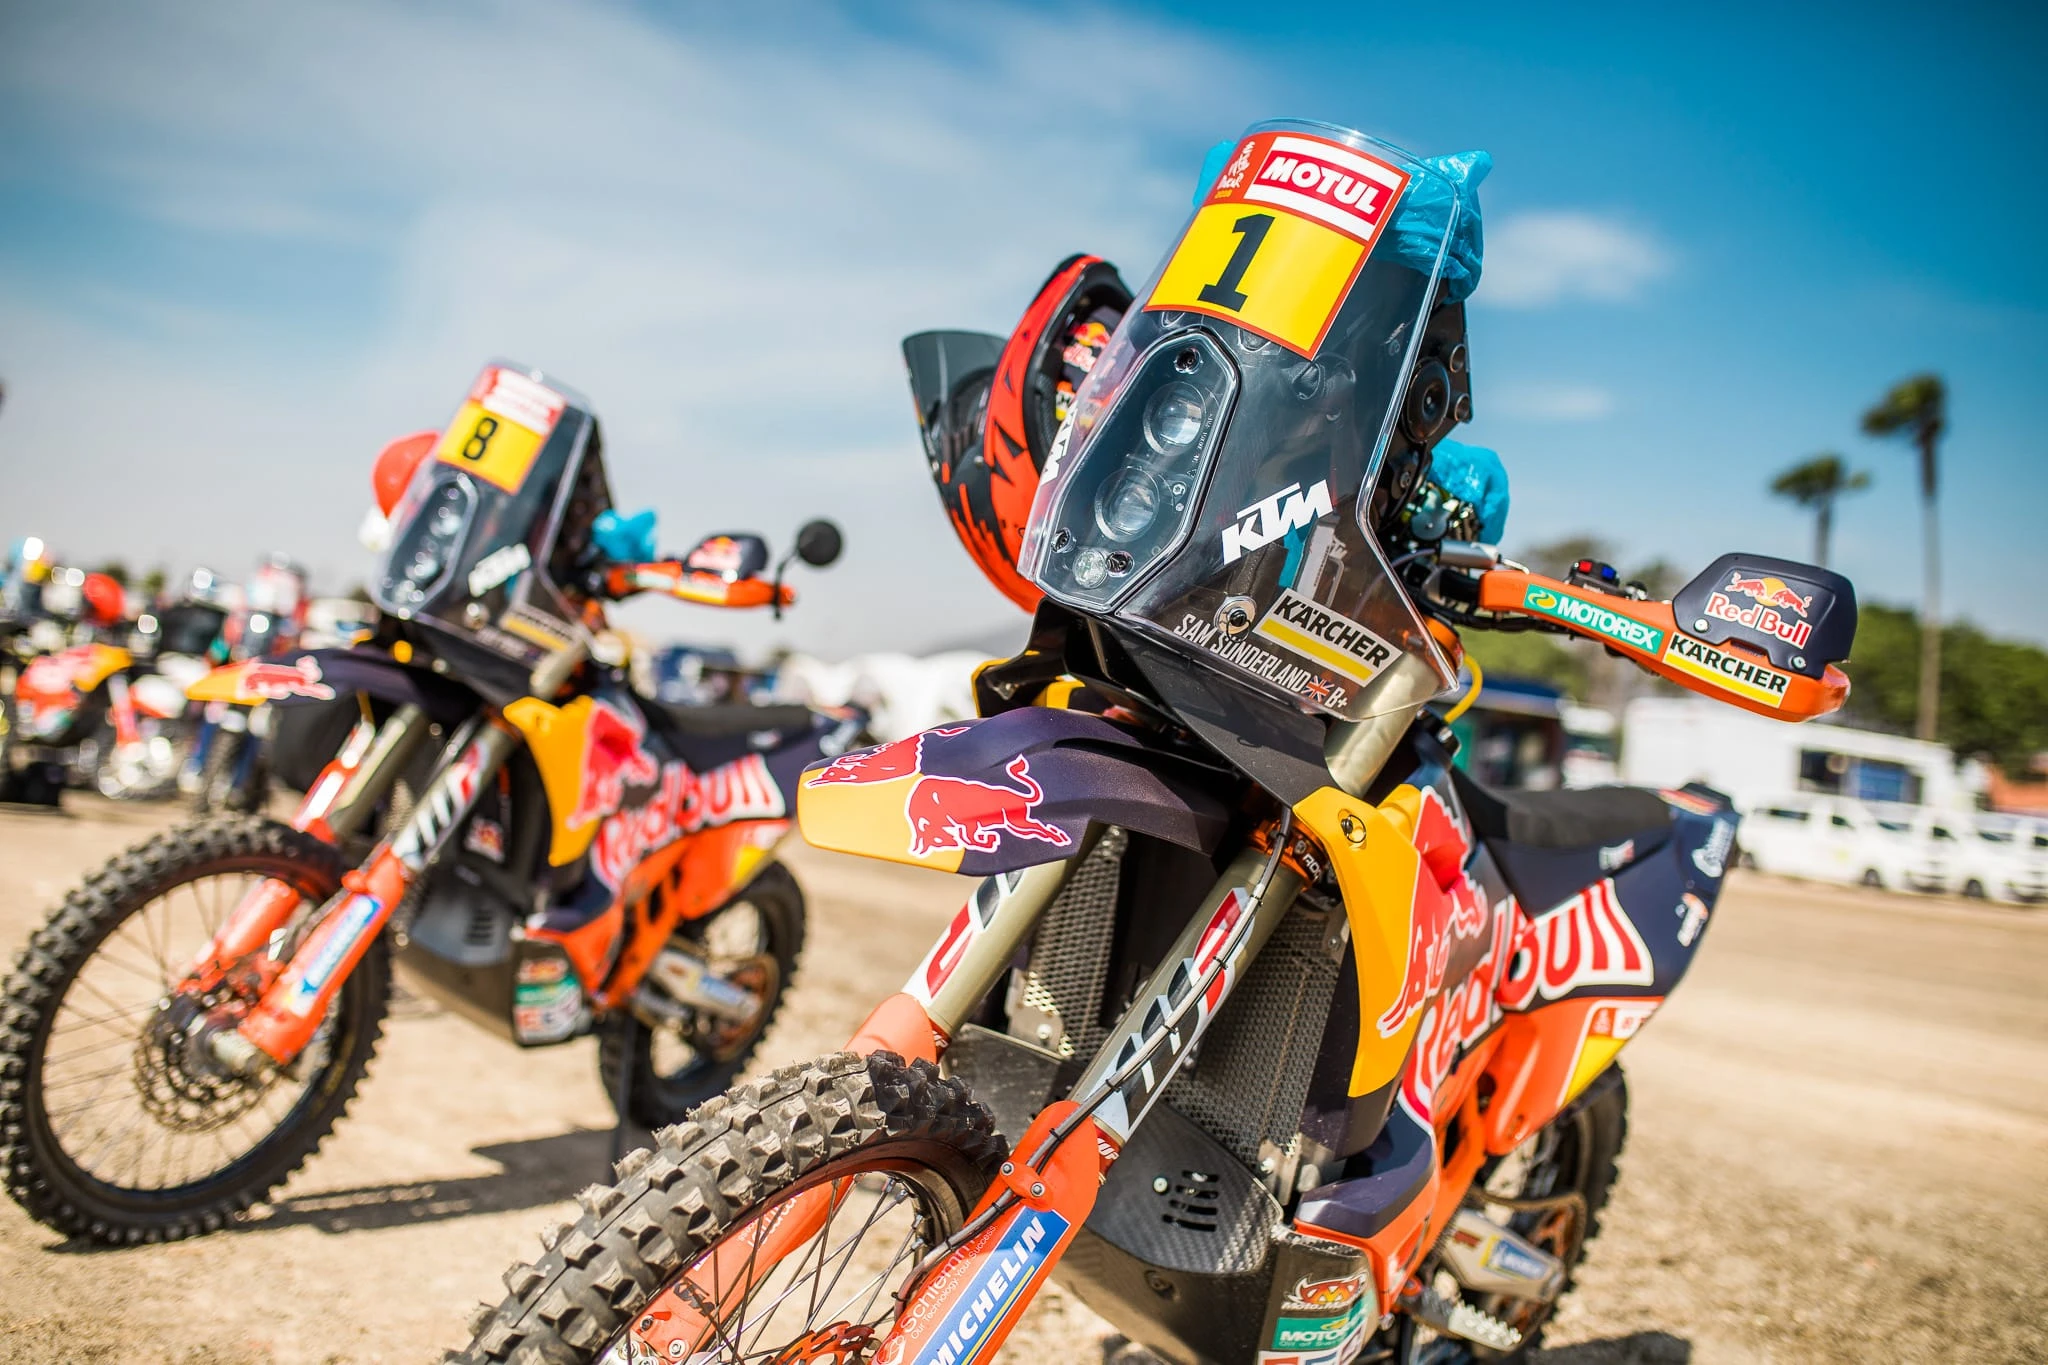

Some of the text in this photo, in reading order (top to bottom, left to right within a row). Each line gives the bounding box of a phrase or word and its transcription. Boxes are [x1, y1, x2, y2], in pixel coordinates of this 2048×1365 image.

[1261, 156, 1385, 215] MOTUL
[1197, 213, 1276, 312] 1
[463, 417, 498, 461] 8
[1221, 479, 1333, 565] KTM
[1273, 595, 1391, 668] KÄRCHER
[1556, 596, 1659, 651] MOTOREX
[1704, 591, 1813, 649] Red Bull
[1173, 613, 1348, 709] SAM SUNDERLAND B+
[1669, 634, 1788, 694] KÄRCHER
[1497, 877, 1653, 1010] Bull
[928, 1216, 1046, 1365] MICHELIN
